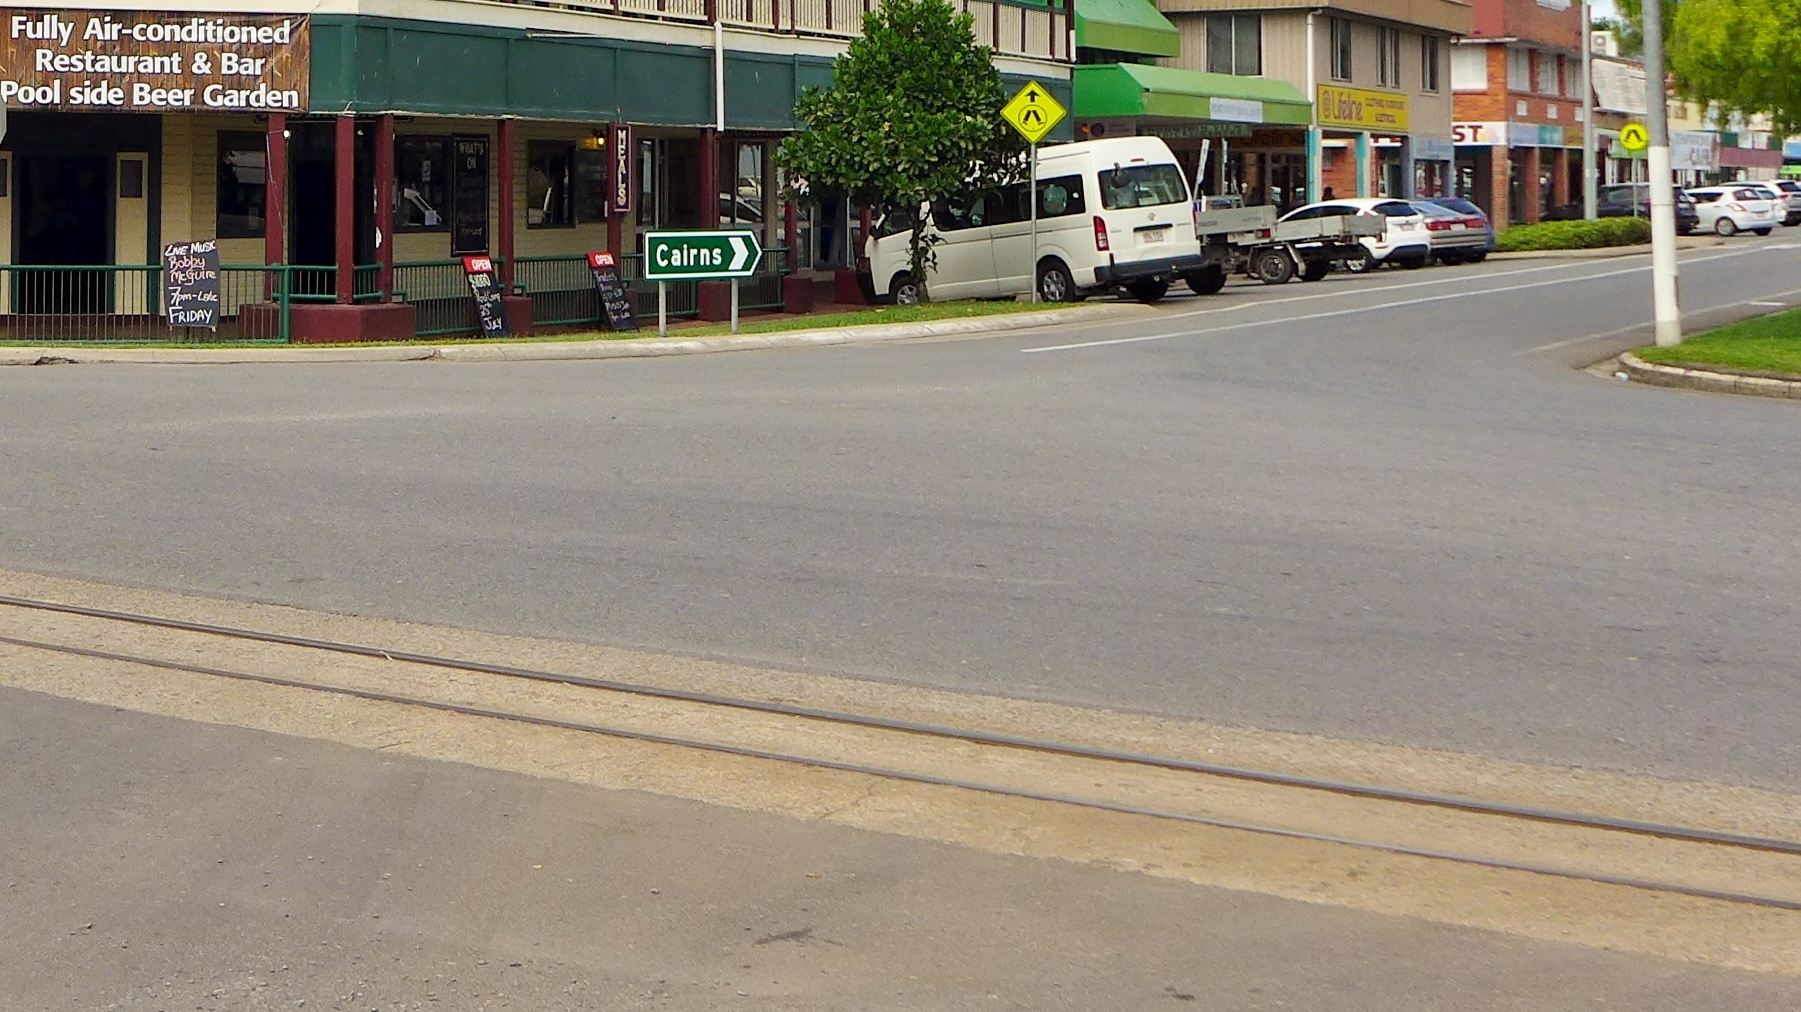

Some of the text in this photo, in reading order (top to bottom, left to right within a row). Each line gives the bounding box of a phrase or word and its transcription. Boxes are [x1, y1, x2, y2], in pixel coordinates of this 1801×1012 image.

[11, 15, 290, 46] Fully Air-conditioned
[35, 49, 265, 76] Restaurant & Bar
[2, 79, 300, 109] Pool side Beer Garden
[617, 129, 627, 206] MEALS
[164, 244, 189, 257] LIVE
[594, 253, 615, 266] OPEN
[656, 243, 723, 267] Cairns
[168, 255, 206, 271] Bobby
[471, 258, 492, 272] OPEN
[168, 306, 213, 324] FRIDAY
